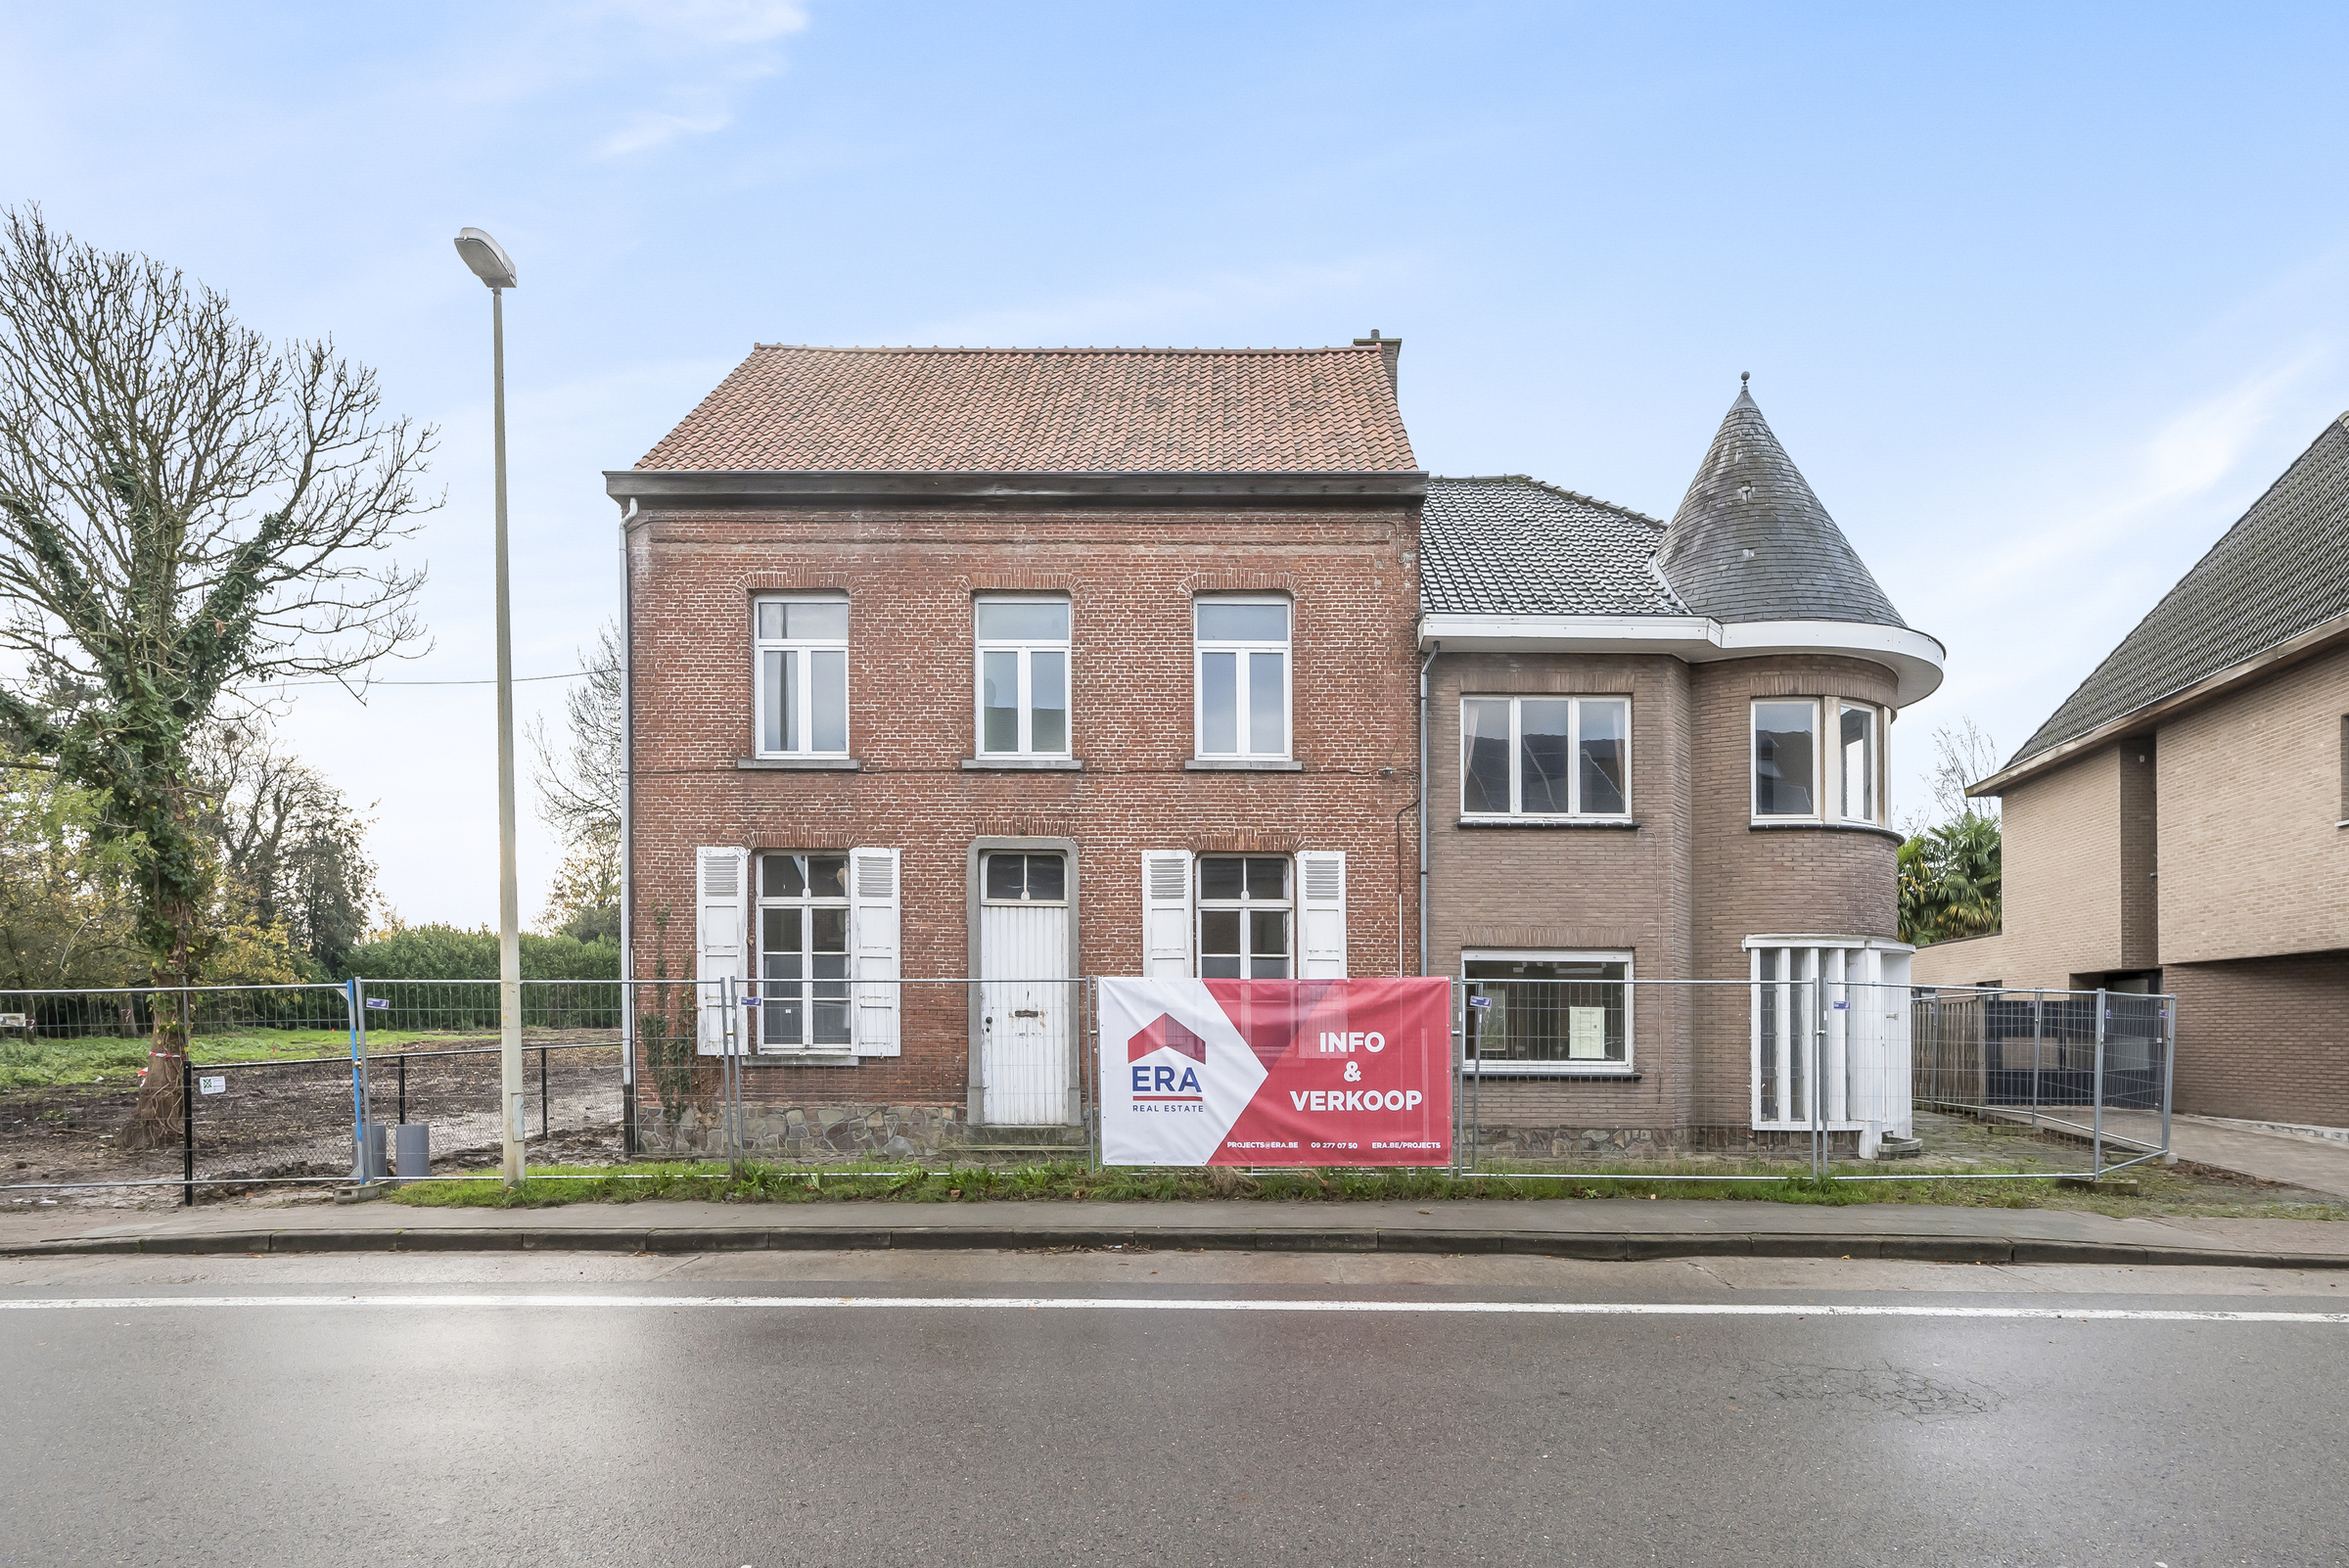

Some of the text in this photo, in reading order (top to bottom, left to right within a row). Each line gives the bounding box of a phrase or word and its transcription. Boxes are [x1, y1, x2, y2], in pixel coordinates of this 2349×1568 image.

[1319, 1031, 1386, 1053] INFO
[1132, 1066, 1202, 1092] ERA
[1343, 1060, 1362, 1083] &
[1289, 1089, 1423, 1112] VERKOOP
